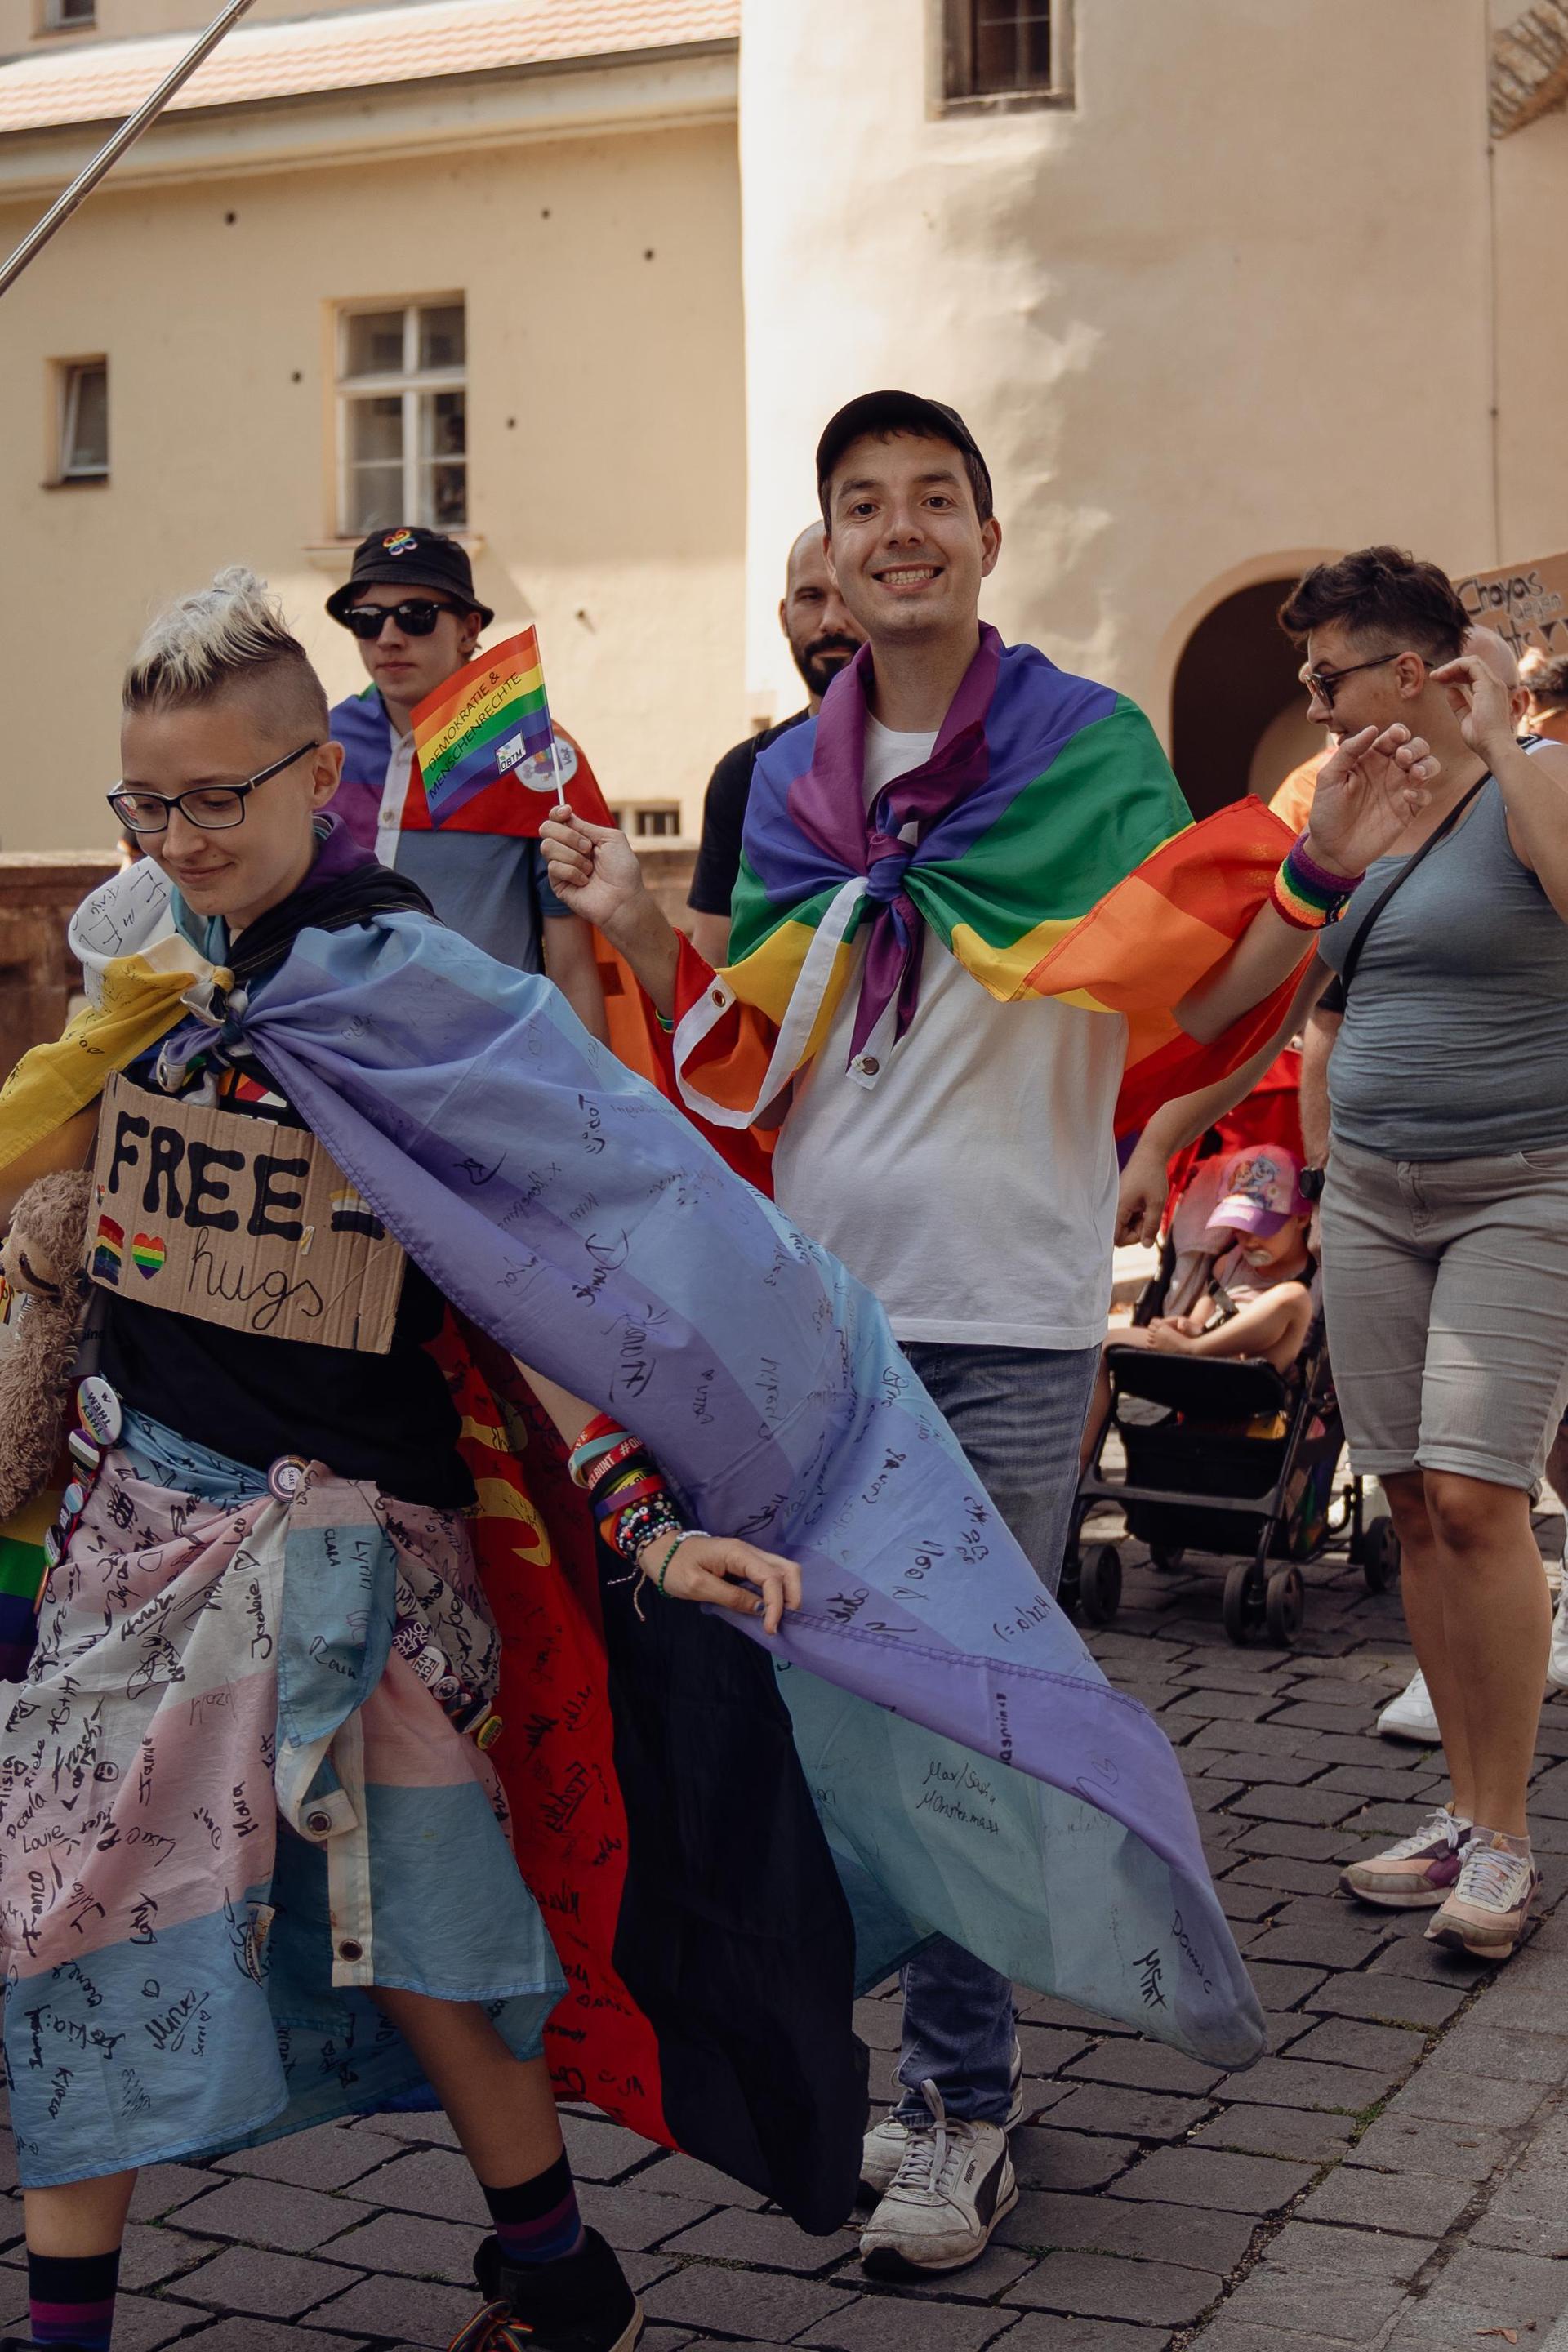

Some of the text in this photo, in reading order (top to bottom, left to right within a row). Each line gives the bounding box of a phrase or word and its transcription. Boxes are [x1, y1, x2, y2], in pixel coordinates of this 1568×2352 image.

[427, 671, 501, 773] DEMOKRATIE &
[427, 671, 523, 800] MENSCHENRECHTE
[108, 1111, 310, 1241] FREE
[189, 1227, 324, 1331] hugs
[82, 1405, 105, 1436] THEY
[88, 1392, 111, 1428] THEM
[323, 1528, 341, 1567] CLARA
[349, 1540, 373, 1590] Lynn
[402, 1630, 430, 1659] SUPE
[420, 1658, 436, 1682] FCK
[964, 2163, 976, 2185] PUMA
